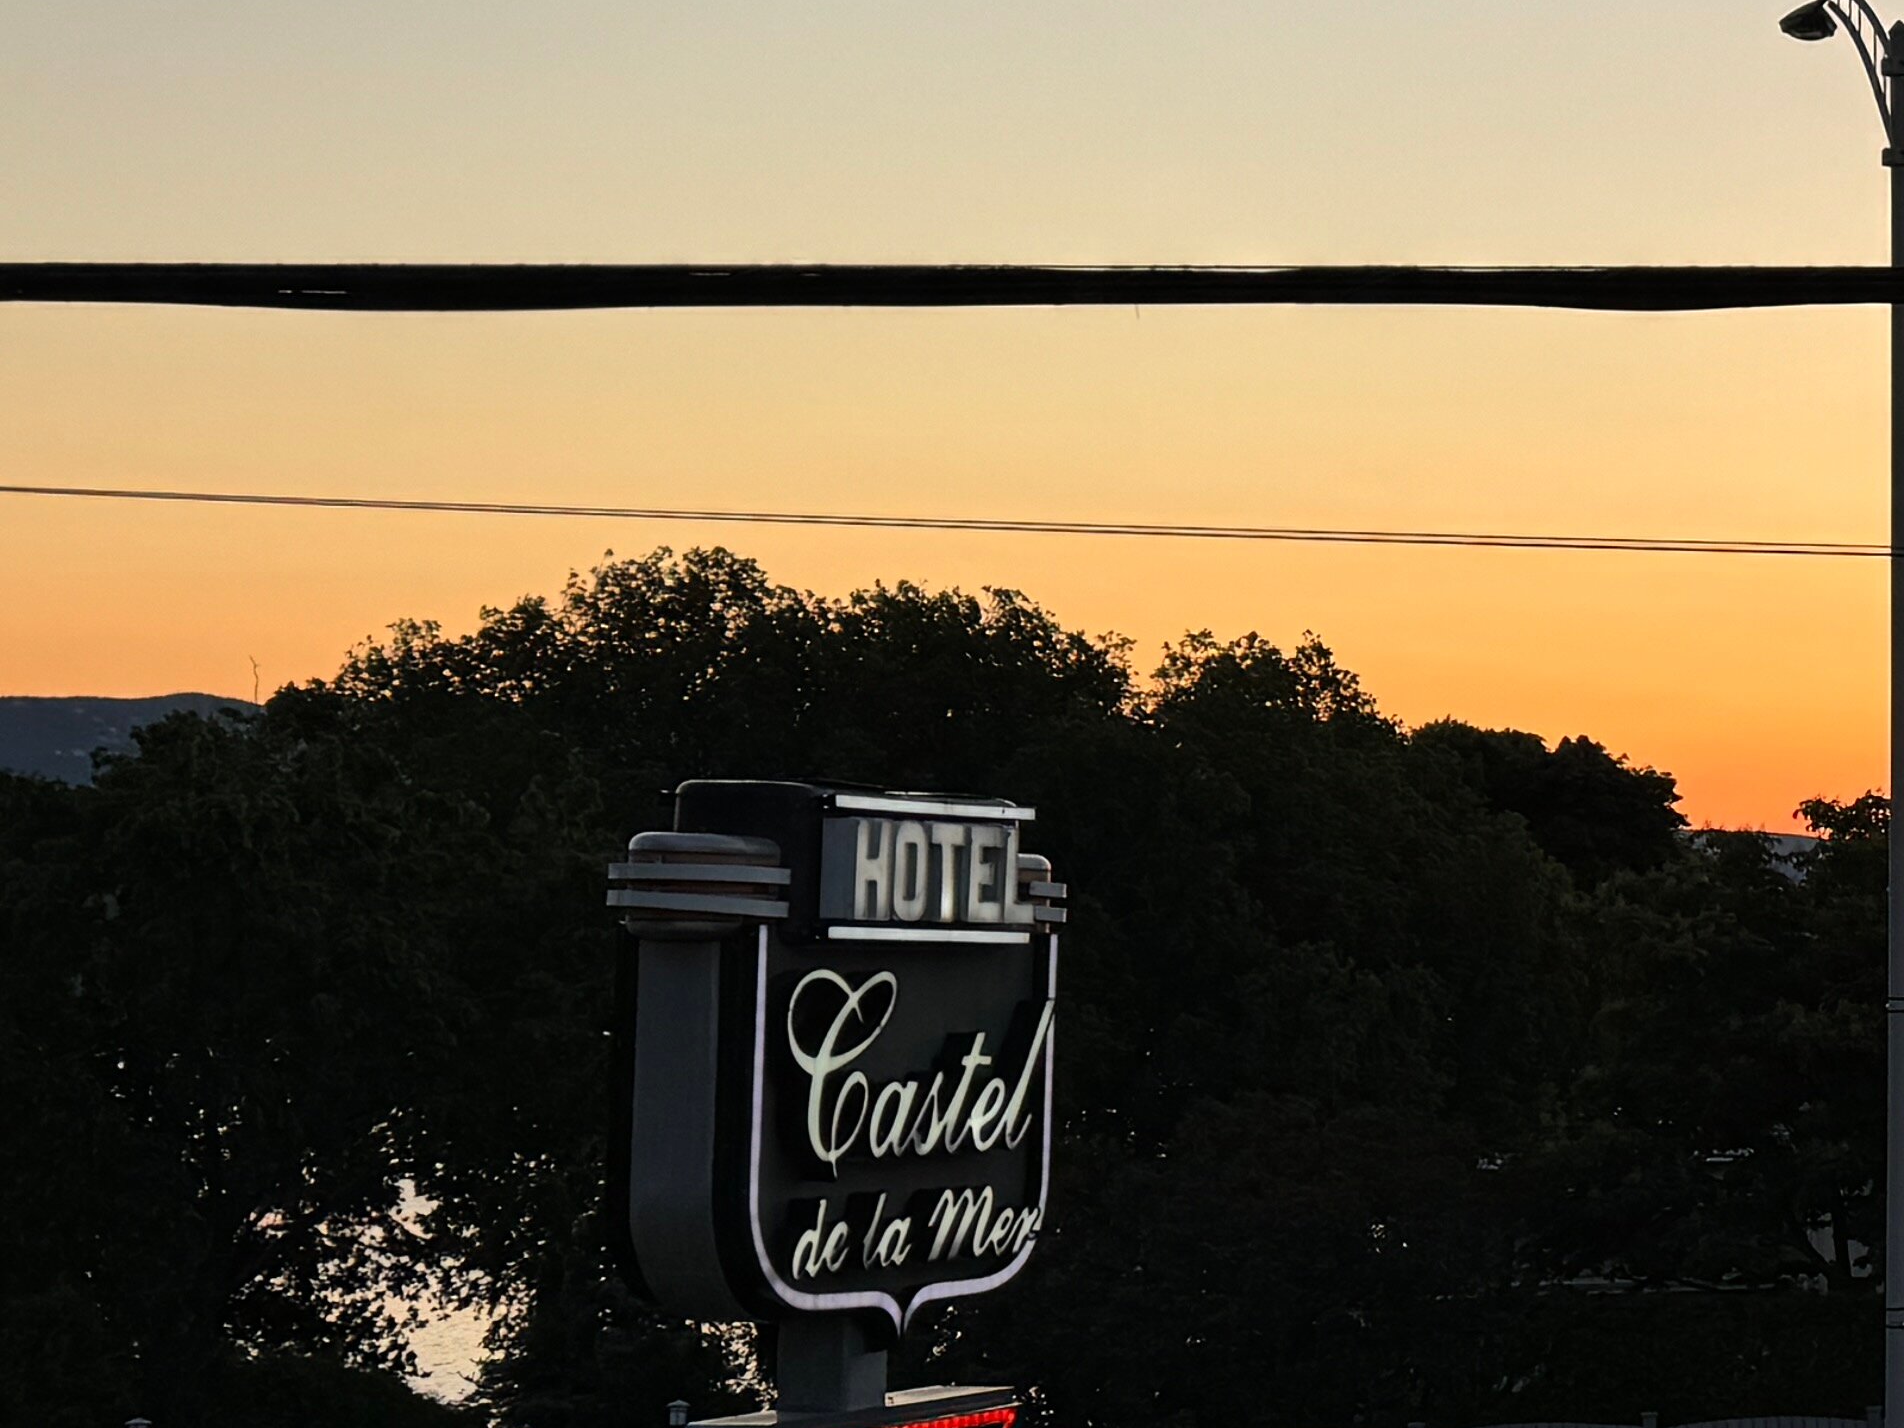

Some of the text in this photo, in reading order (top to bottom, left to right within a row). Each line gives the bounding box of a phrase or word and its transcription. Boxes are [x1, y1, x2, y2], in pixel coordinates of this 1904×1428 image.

[854, 819, 1034, 924] HOTEL
[787, 968, 1055, 1181] Castel
[791, 1184, 1041, 1281] de la Mer
